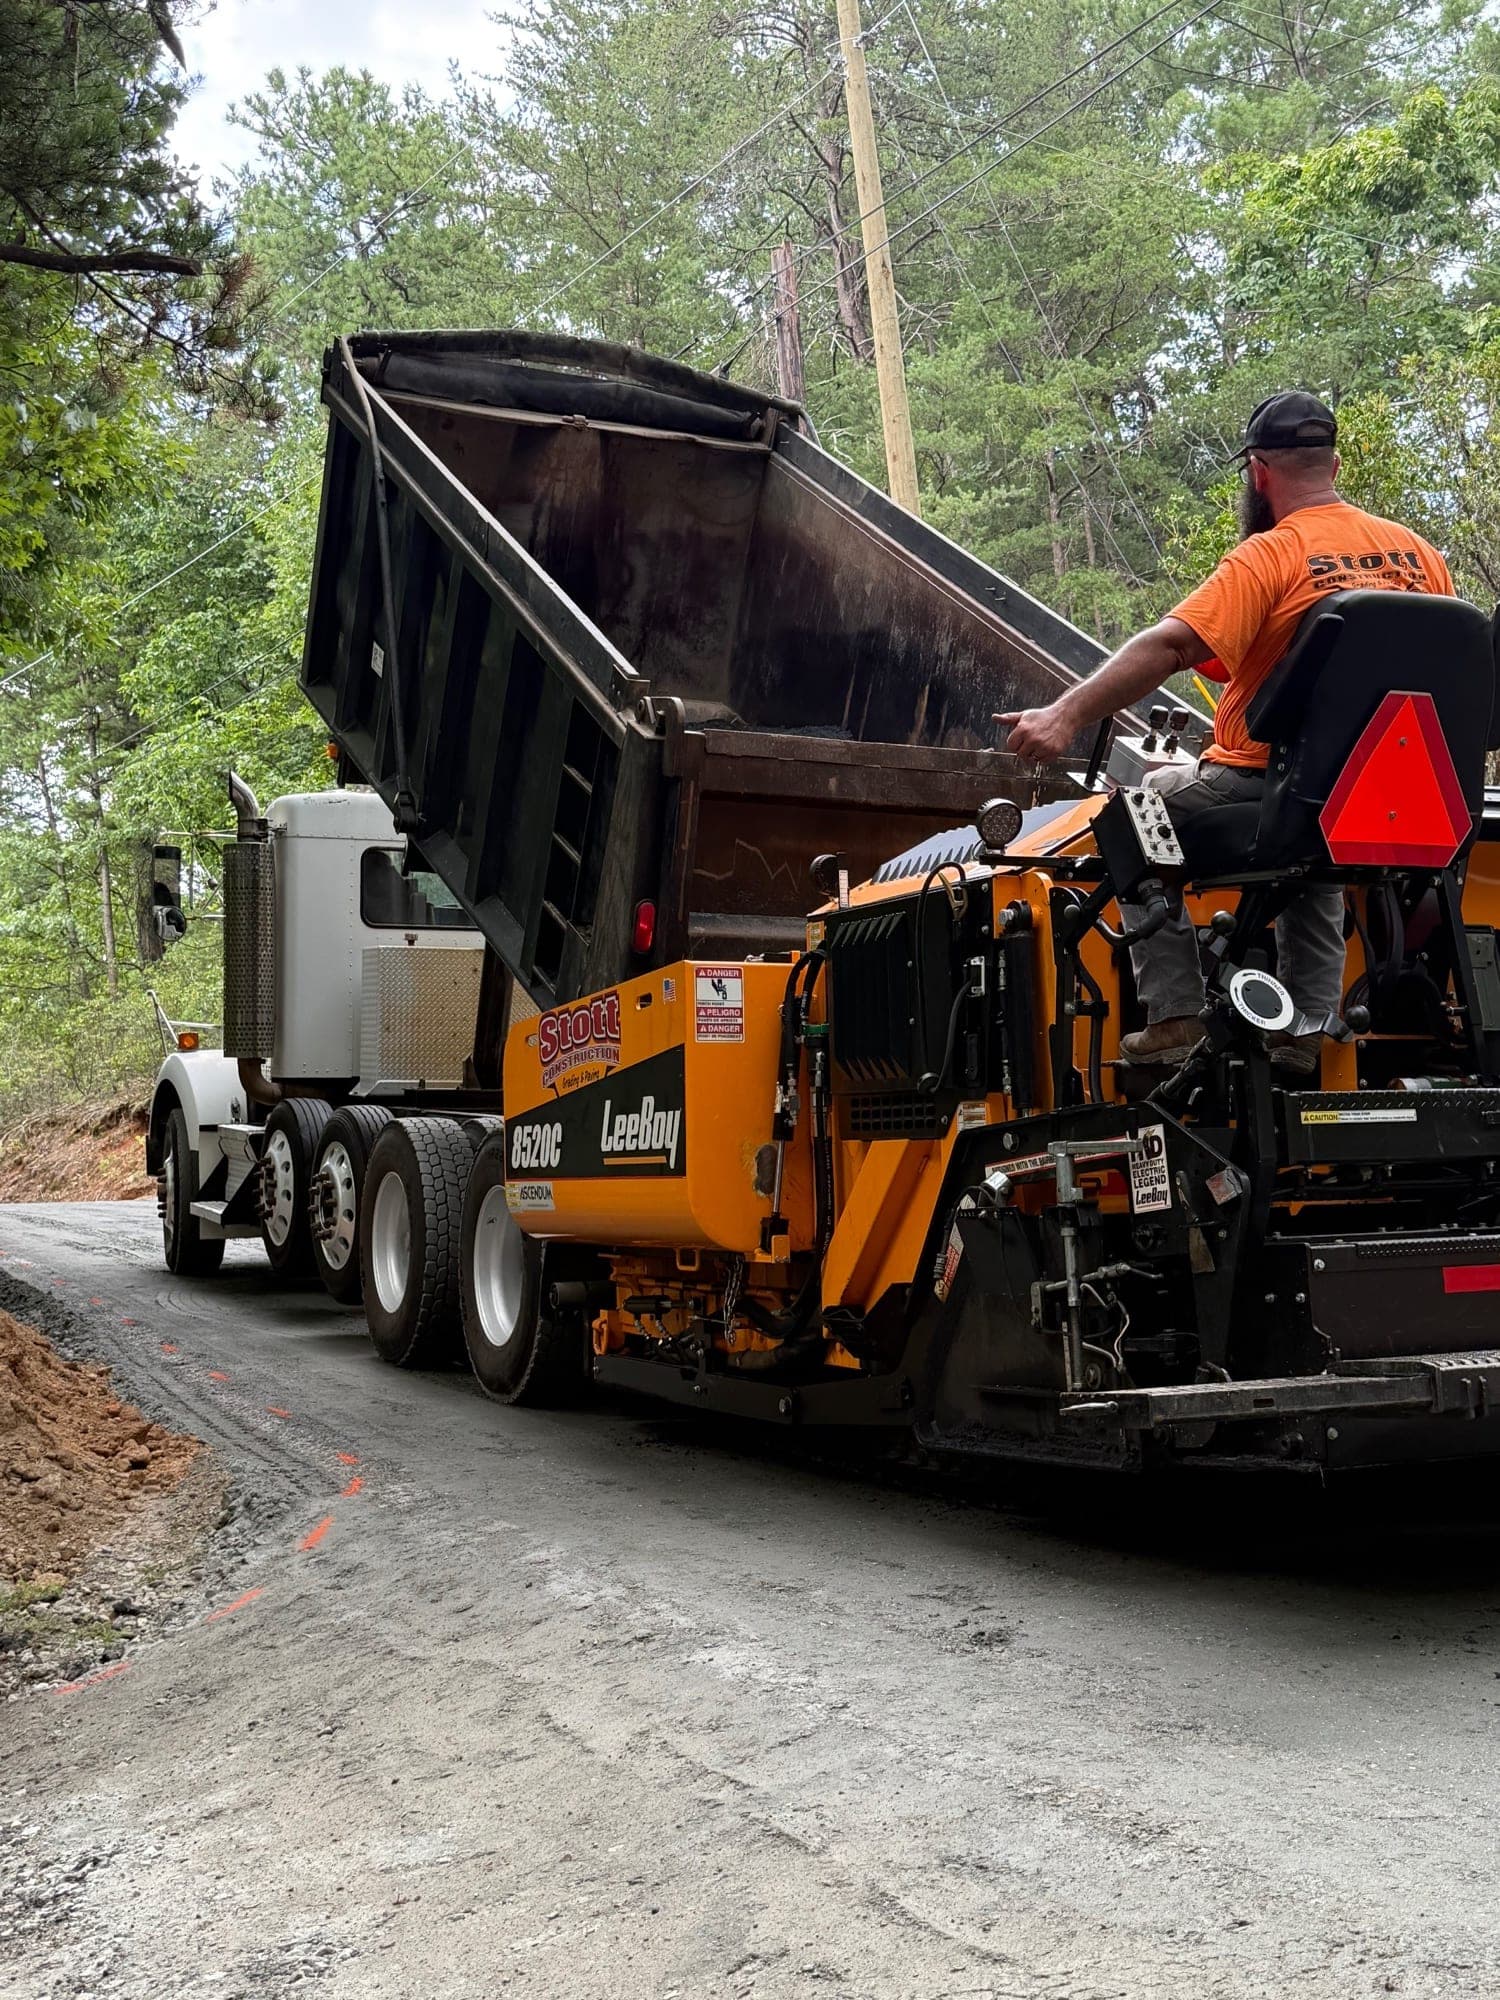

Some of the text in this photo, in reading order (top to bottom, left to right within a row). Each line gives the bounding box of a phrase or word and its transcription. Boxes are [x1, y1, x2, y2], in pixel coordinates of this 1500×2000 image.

[1306, 549, 1424, 578] Stott
[707, 969, 739, 977] DANGER
[707, 1009, 740, 1017] PELIGRO
[539, 990, 621, 1067] Stott
[708, 1025, 740, 1033] DANGER
[542, 1045, 621, 1088] CONSTRUCTION
[601, 1095, 681, 1169] LeeBoy
[511, 1122, 562, 1169] 8520C
[1132, 1165, 1165, 1179] ELECTRIC
[1133, 1175, 1166, 1189] LEGEND
[520, 1183, 553, 1200] ASCENDUM
[1136, 1187, 1168, 1205] LeeBoy
